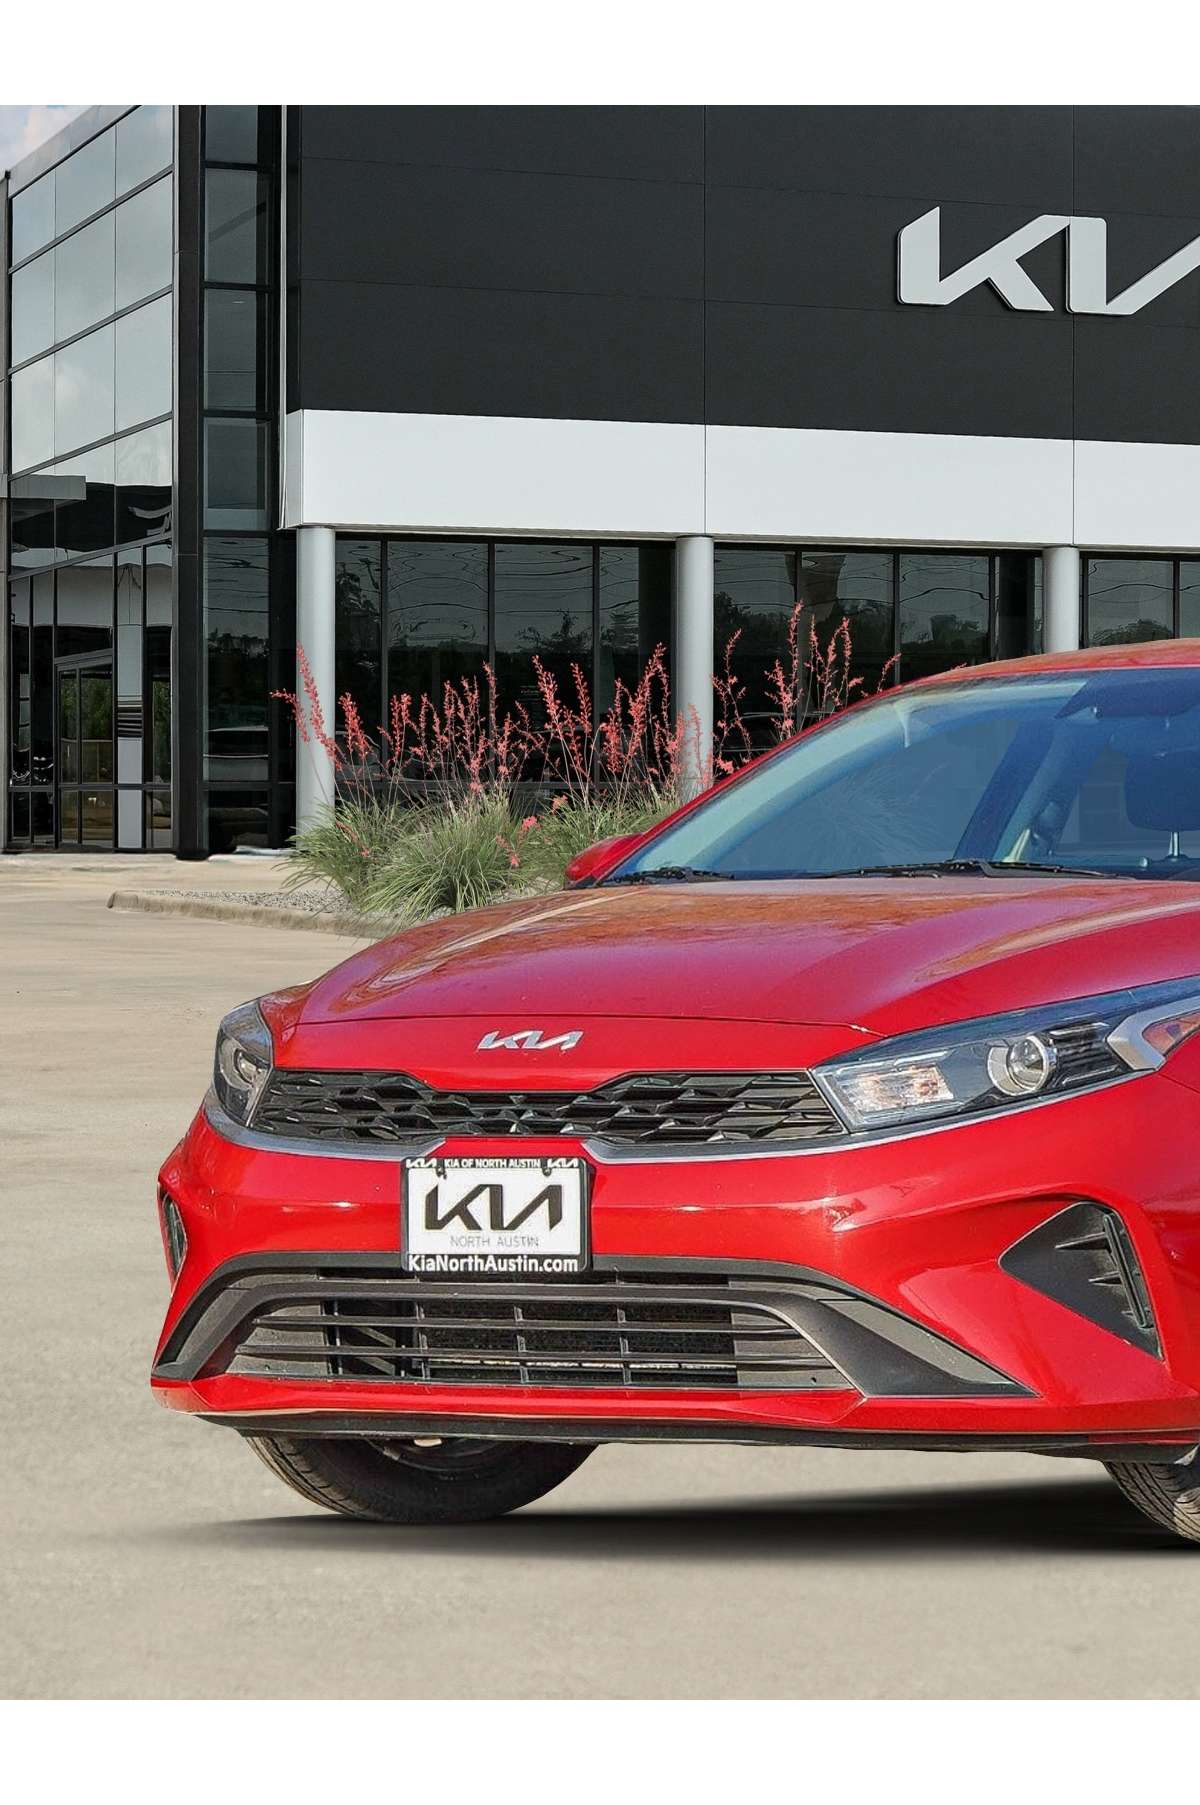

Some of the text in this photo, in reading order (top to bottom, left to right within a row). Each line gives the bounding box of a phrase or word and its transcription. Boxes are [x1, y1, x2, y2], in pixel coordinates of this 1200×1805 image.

[477, 1030, 584, 1050] KIA
[443, 1159, 541, 1169] KIA OF NORTH AUSTIN
[425, 1184, 563, 1231] KIA
[450, 1235, 539, 1247] NORTH AUSTIN
[408, 1254, 579, 1272] KiaNorthAustin.com
